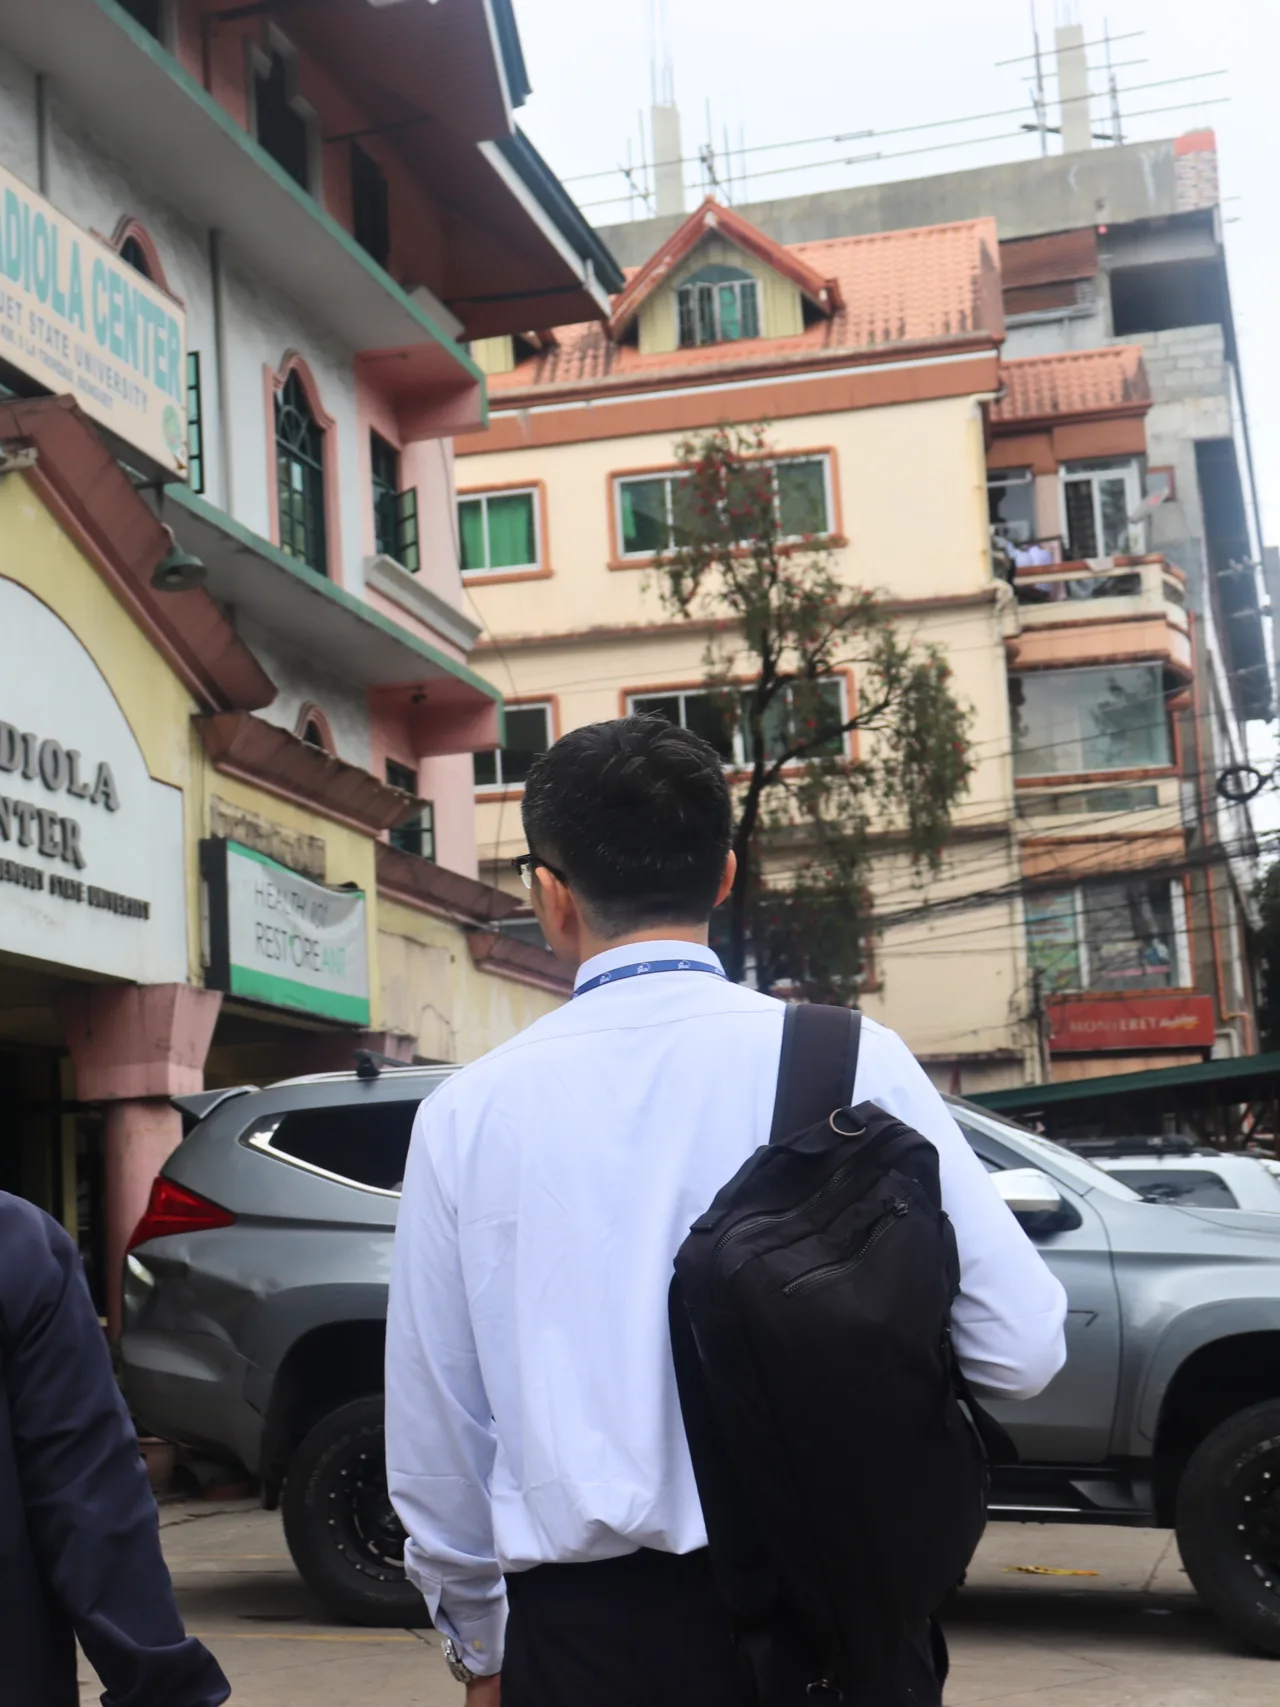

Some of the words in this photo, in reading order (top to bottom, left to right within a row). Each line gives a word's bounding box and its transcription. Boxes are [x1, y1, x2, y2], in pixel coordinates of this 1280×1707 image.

[28, 311, 70, 359] STATE
[75, 343, 149, 414] UNIVERSITY
[91, 256, 183, 404] CENTER
